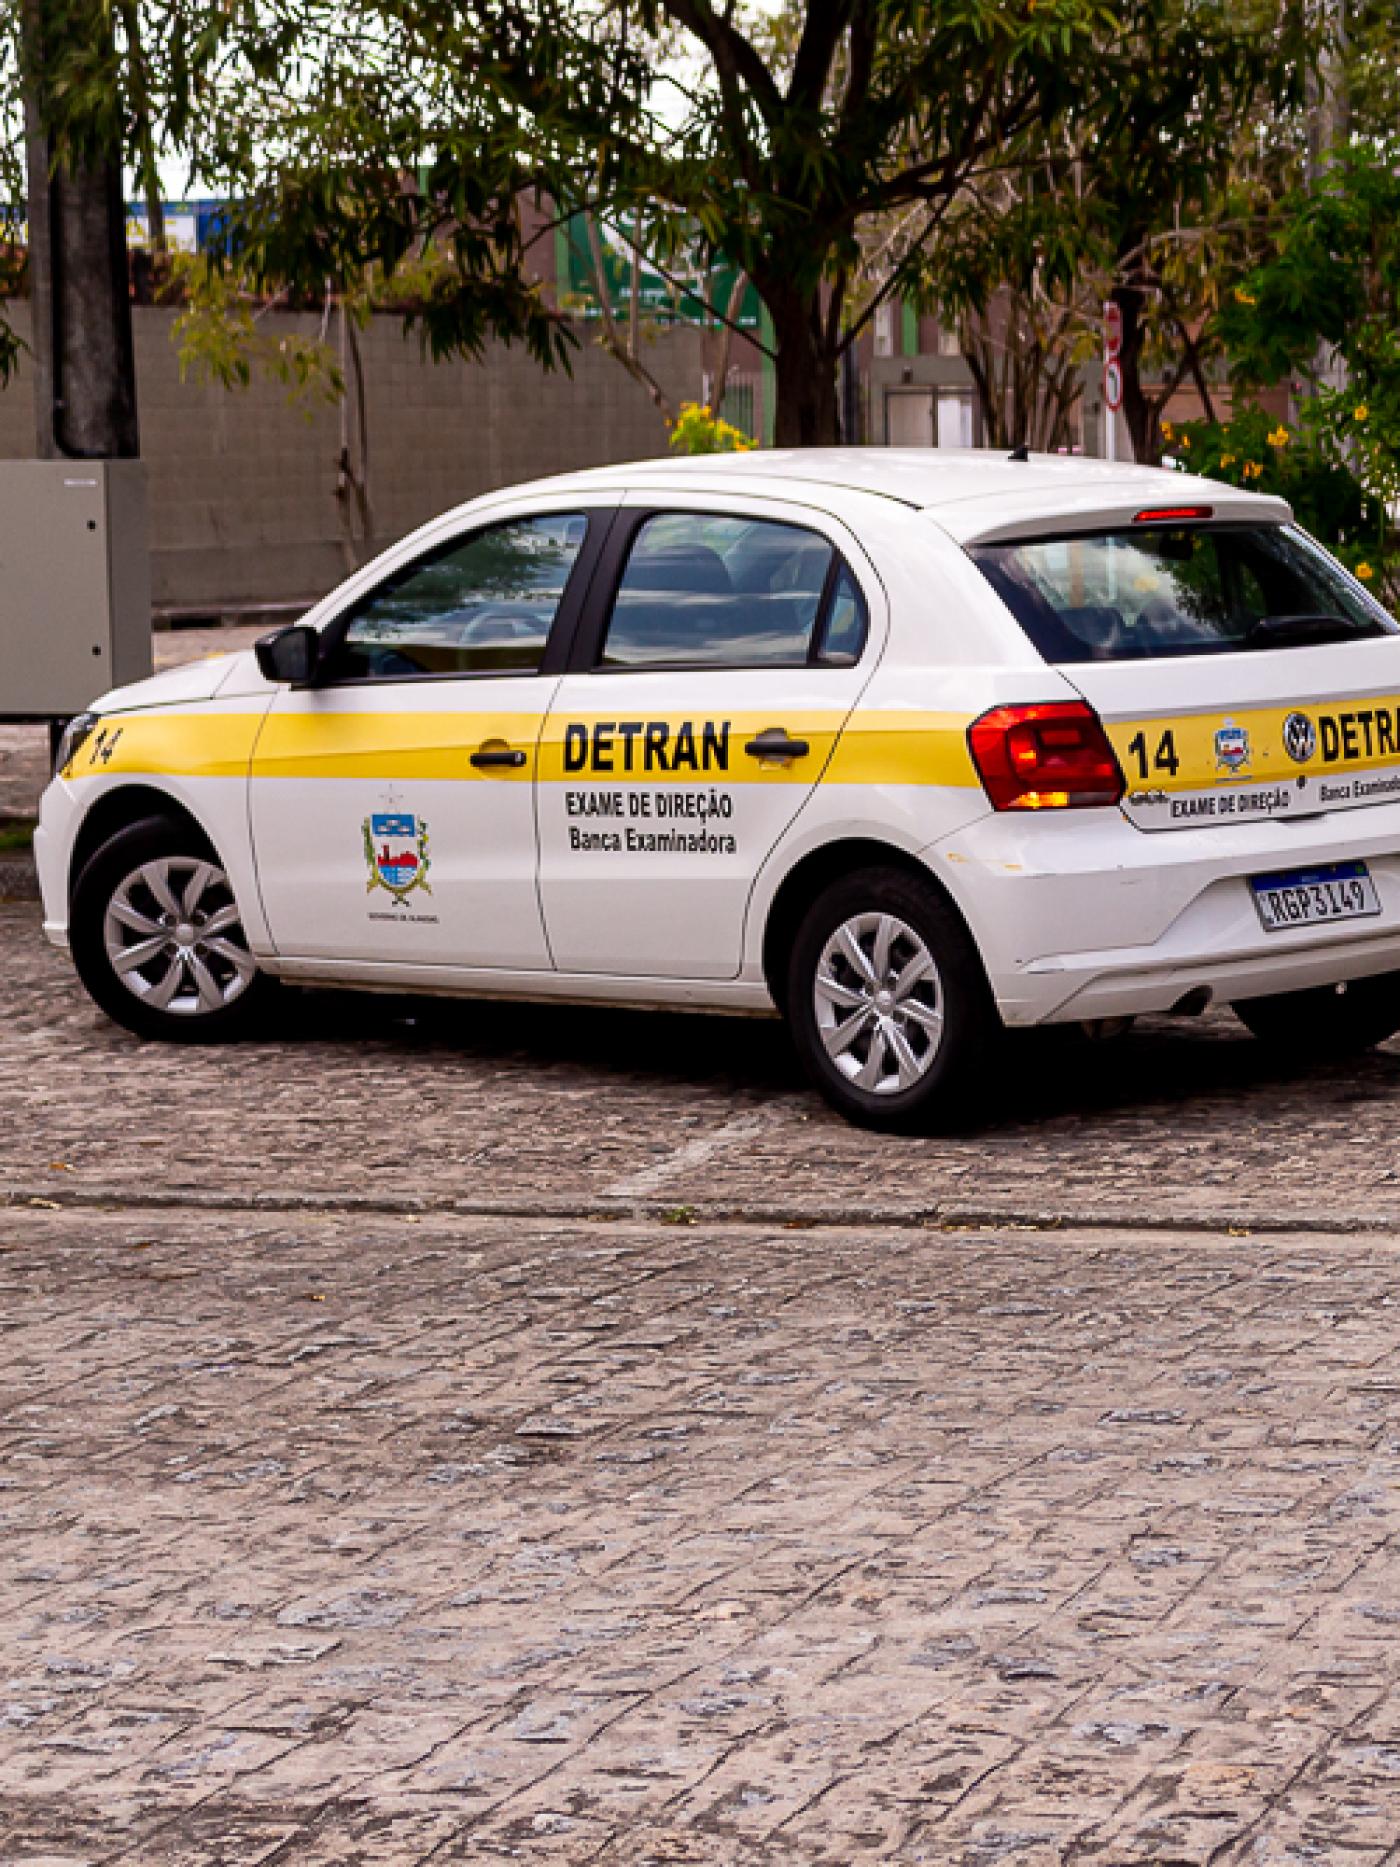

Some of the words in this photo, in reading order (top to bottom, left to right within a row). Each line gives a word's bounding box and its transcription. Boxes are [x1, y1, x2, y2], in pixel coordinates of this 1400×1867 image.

[563, 722, 731, 772] DETRAN
[1128, 728, 1179, 778] 14
[565, 791, 625, 818] EXAME
[627, 792, 652, 818] DE
[655, 787, 733, 825] DIREÇÃO
[1170, 796, 1216, 818] EXAME
[1218, 795, 1236, 814] DE
[568, 826, 623, 851] Banca
[625, 828, 737, 854] Examinadora
